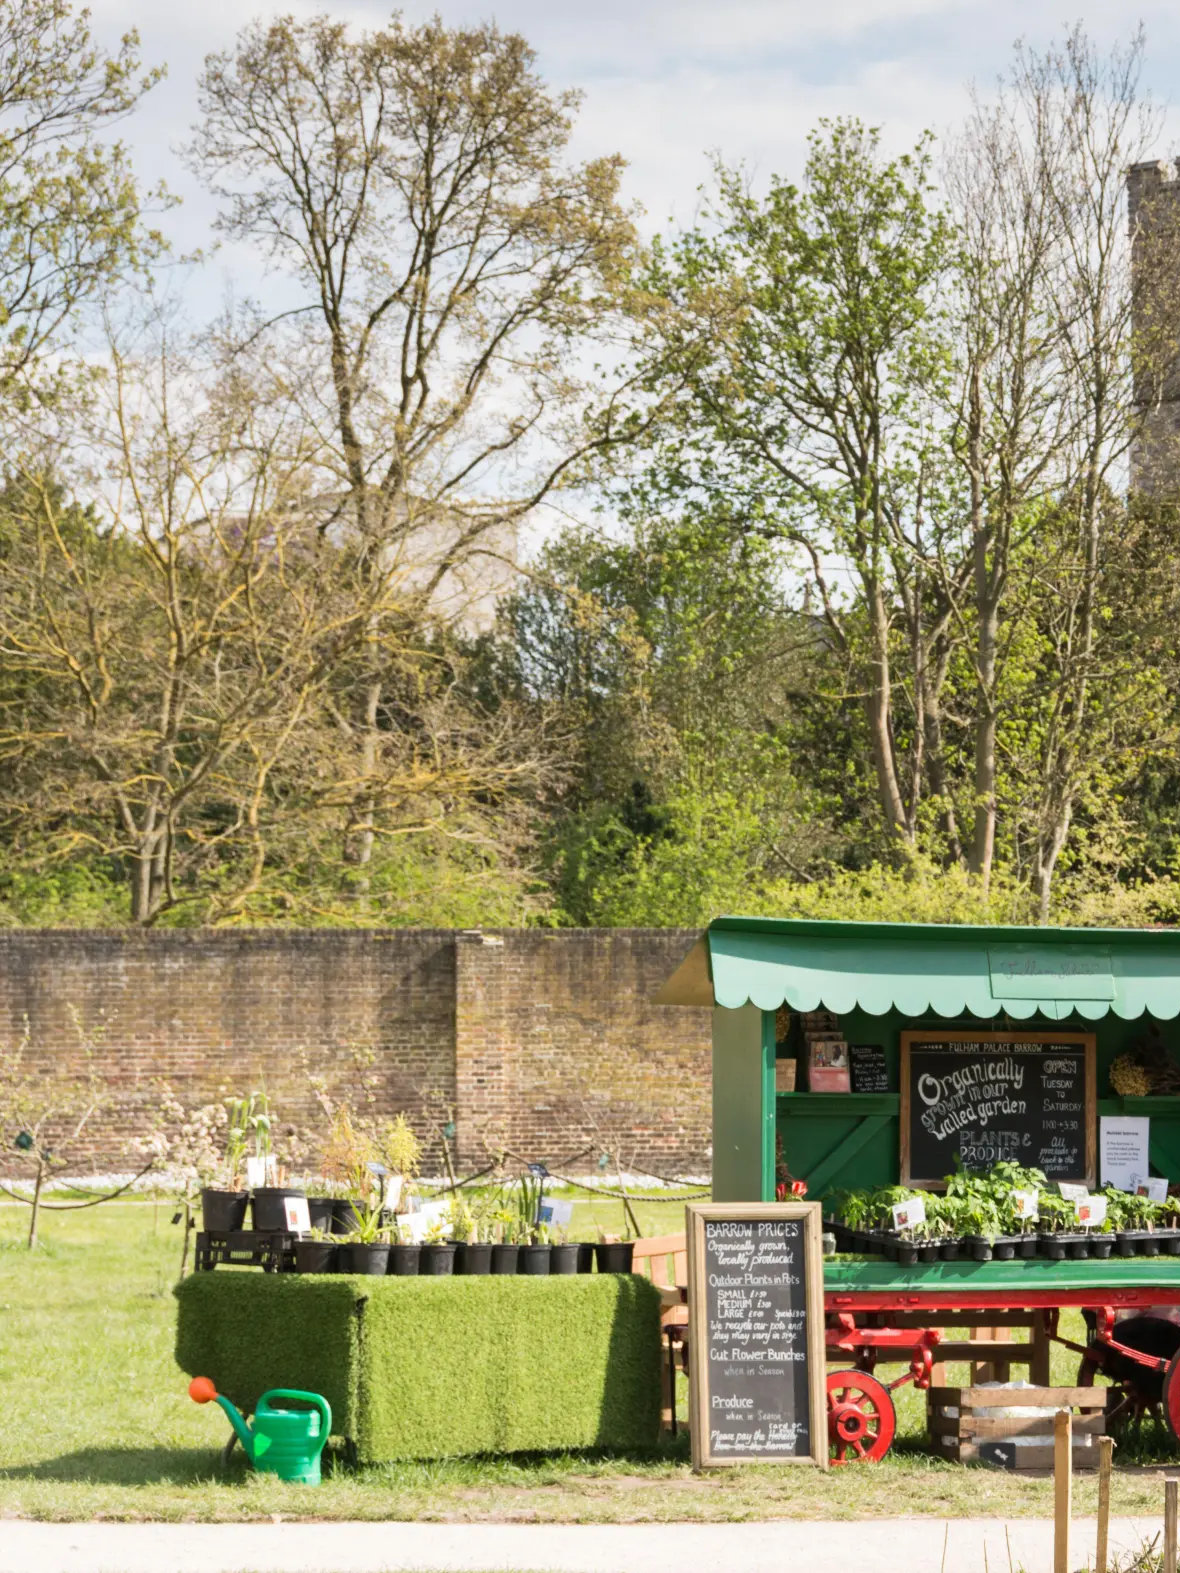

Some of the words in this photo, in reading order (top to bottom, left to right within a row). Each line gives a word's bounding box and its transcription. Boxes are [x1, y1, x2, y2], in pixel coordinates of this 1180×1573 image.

[949, 1042, 980, 1052] FULHAM
[984, 1043, 1011, 1052] PALACE
[1014, 1043, 1042, 1053] BARROW
[1043, 1058, 1077, 1074] OPEN
[917, 1057, 1025, 1106] Organically
[1056, 1091, 1065, 1099] TO
[921, 1093, 966, 1133] grown
[968, 1085, 982, 1101] in
[982, 1083, 1008, 1099] our
[977, 1096, 1026, 1126] garden
[959, 1130, 1020, 1147] PLANTS
[1021, 1132, 1033, 1147] &
[960, 1146, 1018, 1161] PRODUCE
[706, 1223, 753, 1238] BARROW
[758, 1223, 799, 1237] PRICES
[707, 1240, 755, 1256] Organically
[759, 1241, 790, 1256] grown,
[718, 1252, 749, 1270] locally
[748, 1252, 794, 1271] produced
[709, 1274, 743, 1287] Outdoor
[744, 1273, 773, 1285] Plants
[774, 1275, 781, 1284] in
[782, 1273, 800, 1285] Pots
[717, 1289, 747, 1299] SMALL
[717, 1299, 752, 1309] MEDIUM
[718, 1309, 745, 1318] LARGE
[710, 1320, 722, 1330] We
[725, 1319, 752, 1333] recycle
[753, 1322, 769, 1330] our
[768, 1321, 786, 1333] pots
[788, 1321, 803, 1330] and
[712, 1330, 730, 1344] they
[731, 1331, 750, 1345] may
[752, 1331, 770, 1345] vary
[772, 1330, 780, 1340] in
[710, 1348, 729, 1361] Cut
[731, 1348, 767, 1360] Flower
[767, 1348, 805, 1361] Bunches
[724, 1364, 744, 1376] when
[746, 1366, 755, 1376] in
[712, 1394, 754, 1408] Produce
[725, 1411, 744, 1421] when
[747, 1412, 754, 1420] in
[710, 1430, 735, 1441] Please
[735, 1432, 753, 1446] pay
[753, 1429, 766, 1441] the
